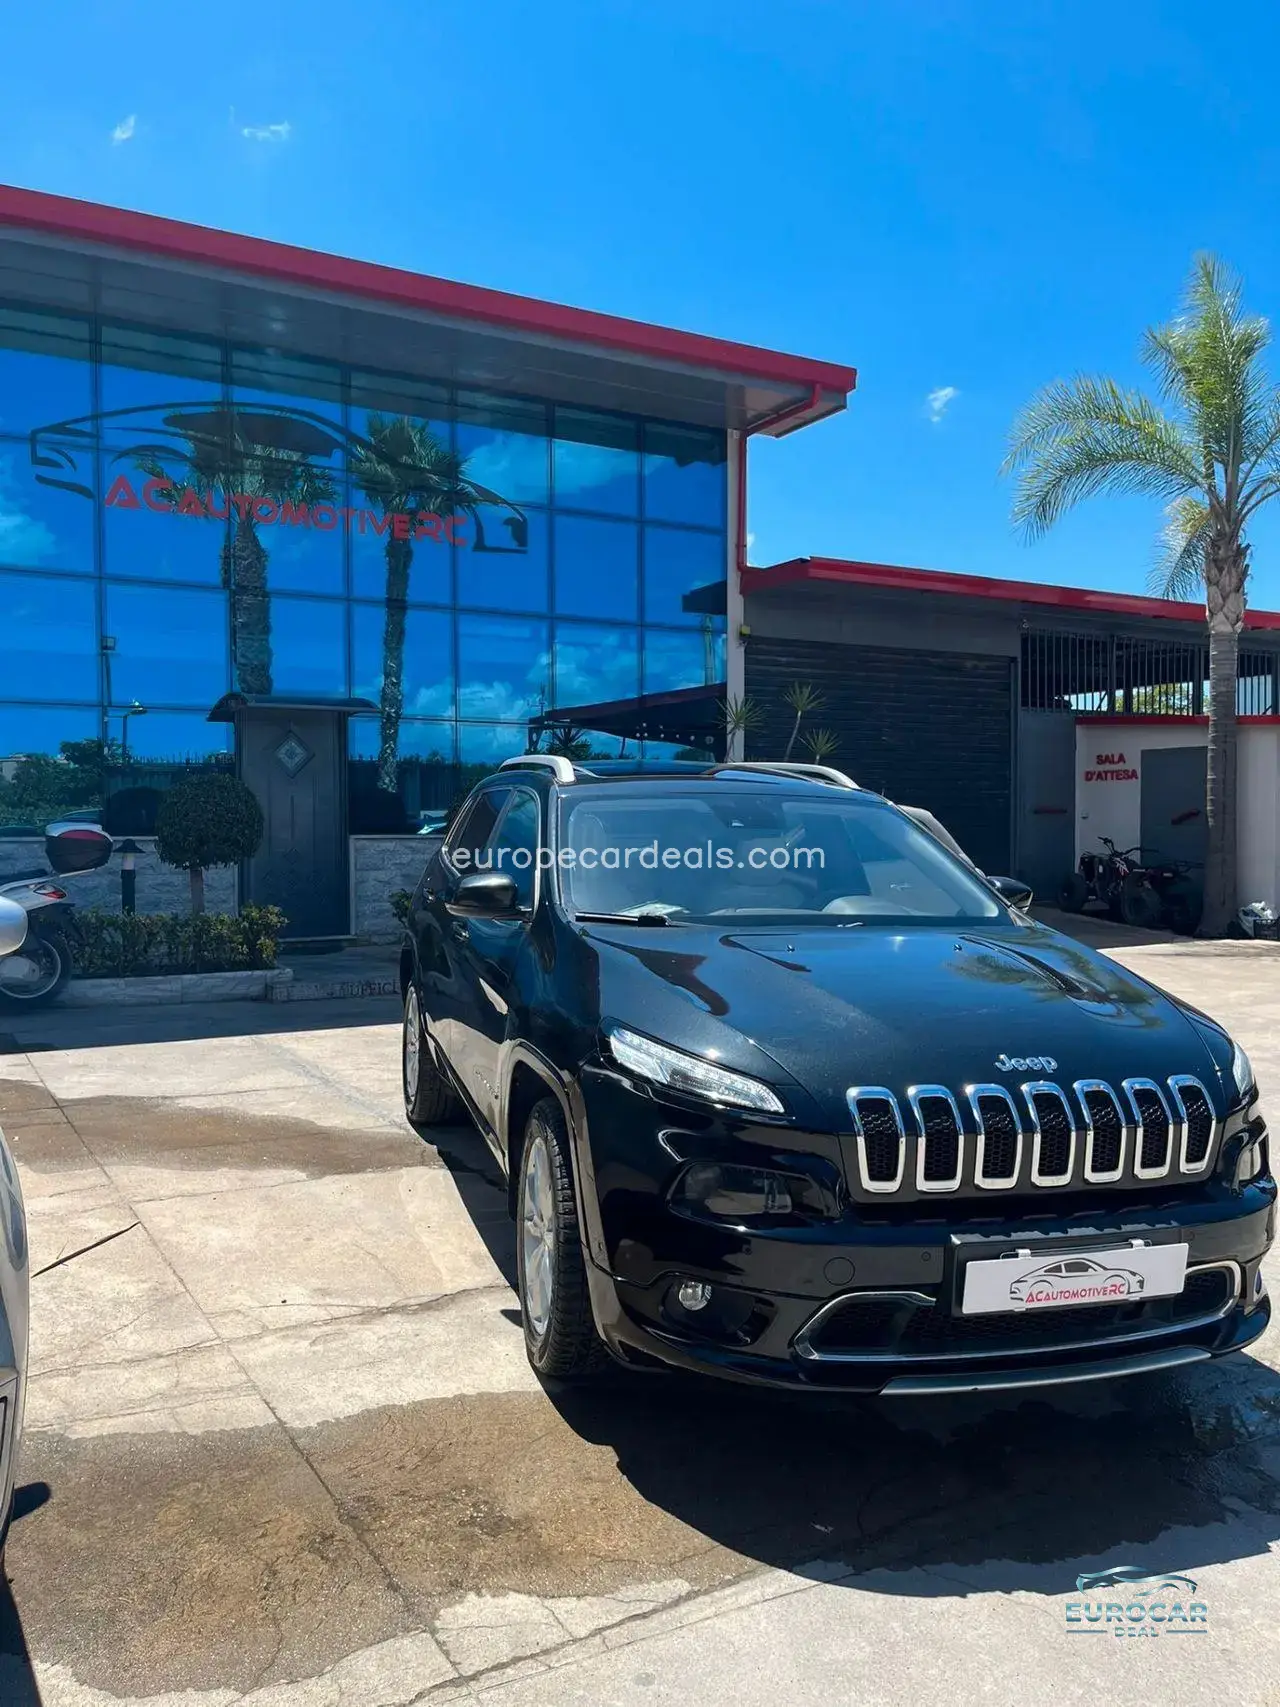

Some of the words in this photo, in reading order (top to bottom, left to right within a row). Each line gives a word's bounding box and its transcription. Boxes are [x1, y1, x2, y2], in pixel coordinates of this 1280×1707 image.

[1096, 753, 1126, 765] SALA
[1084, 769, 1139, 782] D'ATTESA
[995, 1054, 1058, 1073] Jeep
